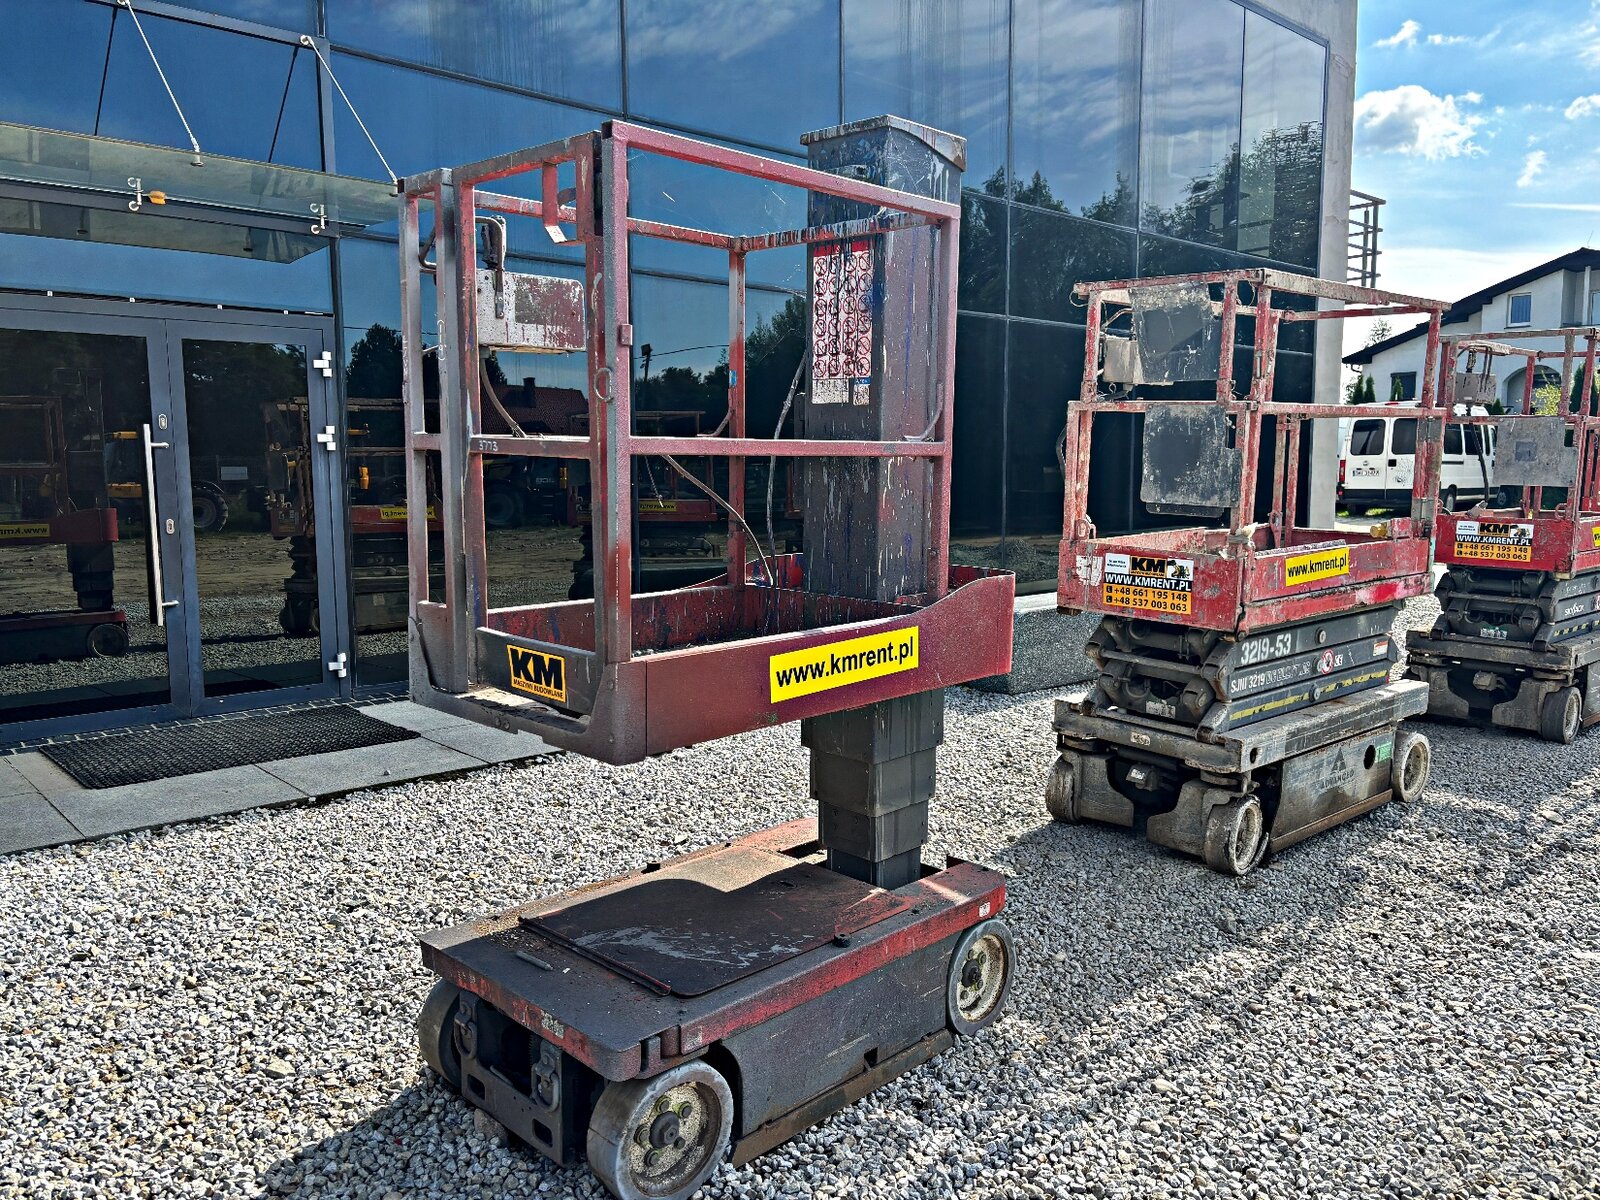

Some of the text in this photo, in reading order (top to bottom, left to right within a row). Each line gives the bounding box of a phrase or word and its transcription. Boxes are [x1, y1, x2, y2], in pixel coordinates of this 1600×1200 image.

[479, 440, 498, 452] 3773
[1480, 523, 1509, 534] KM
[1456, 535, 1531, 546] WWW.KMRENT.PL
[1131, 557, 1165, 572] KM
[1288, 554, 1347, 577] www.kmrent.pl
[1105, 573, 1191, 592] WWW.KMRENT.PL
[1114, 587, 1187, 602] +48 661 195 148
[1113, 596, 1187, 612] +48 537 003 063
[1240, 632, 1292, 665] 3219-53
[510, 647, 563, 691] KM
[776, 635, 914, 688] www.kmrent.pl
[1248, 672, 1266, 689] 3219
